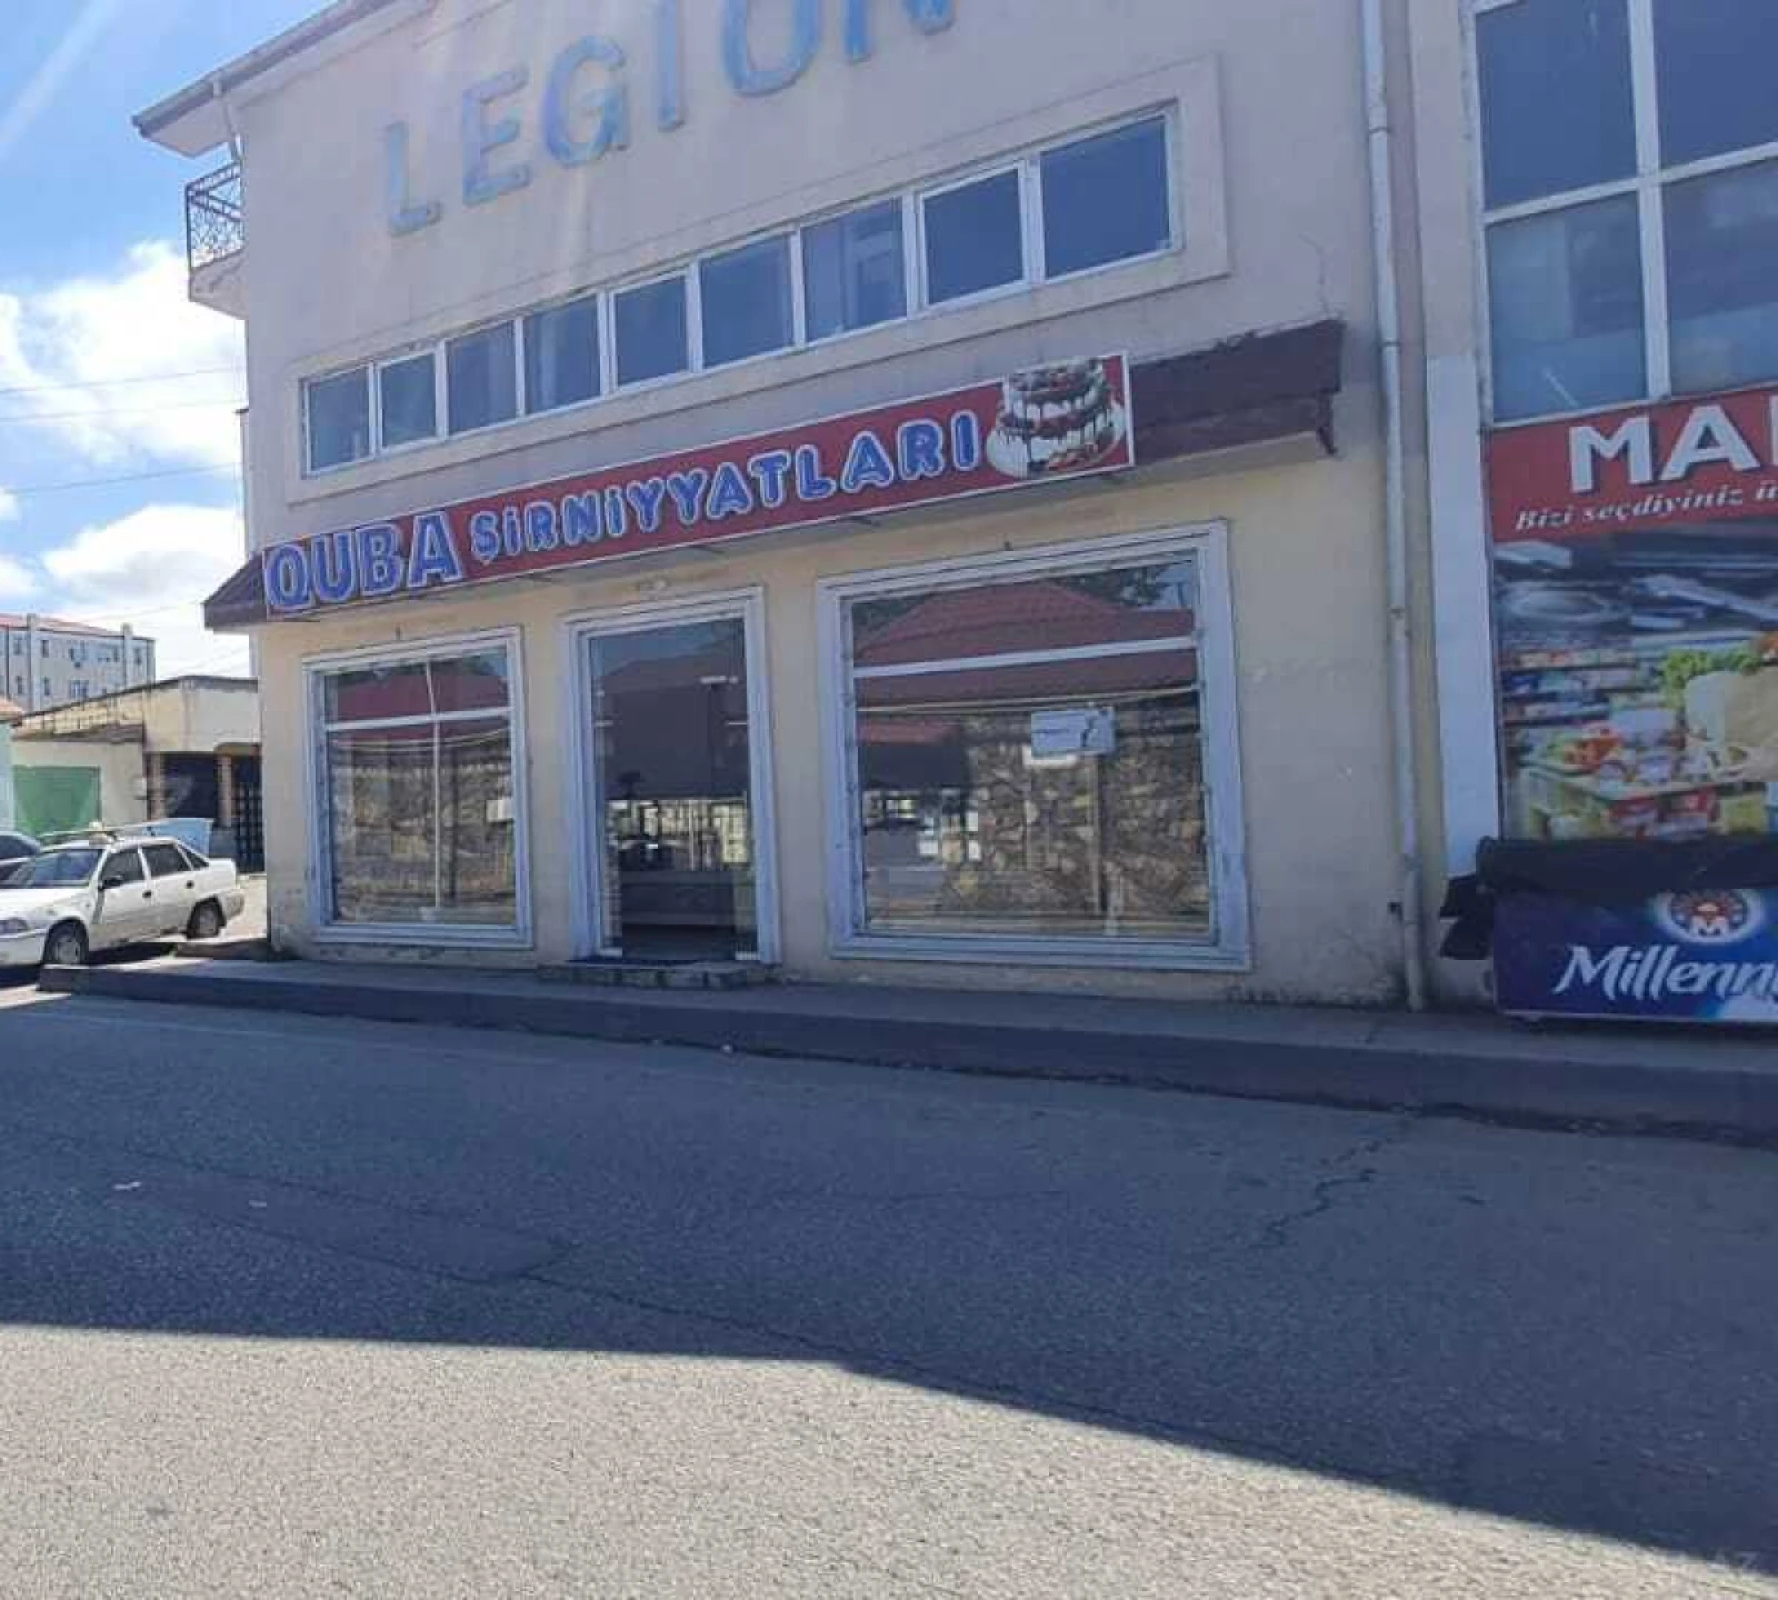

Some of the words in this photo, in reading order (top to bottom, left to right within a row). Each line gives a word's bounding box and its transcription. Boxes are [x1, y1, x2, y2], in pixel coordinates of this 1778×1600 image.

[1569, 395, 1778, 493] MA
[1515, 506, 1574, 531] Bizi
[264, 513, 463, 612] QUBA
[1553, 945, 1778, 1001] Millenn
